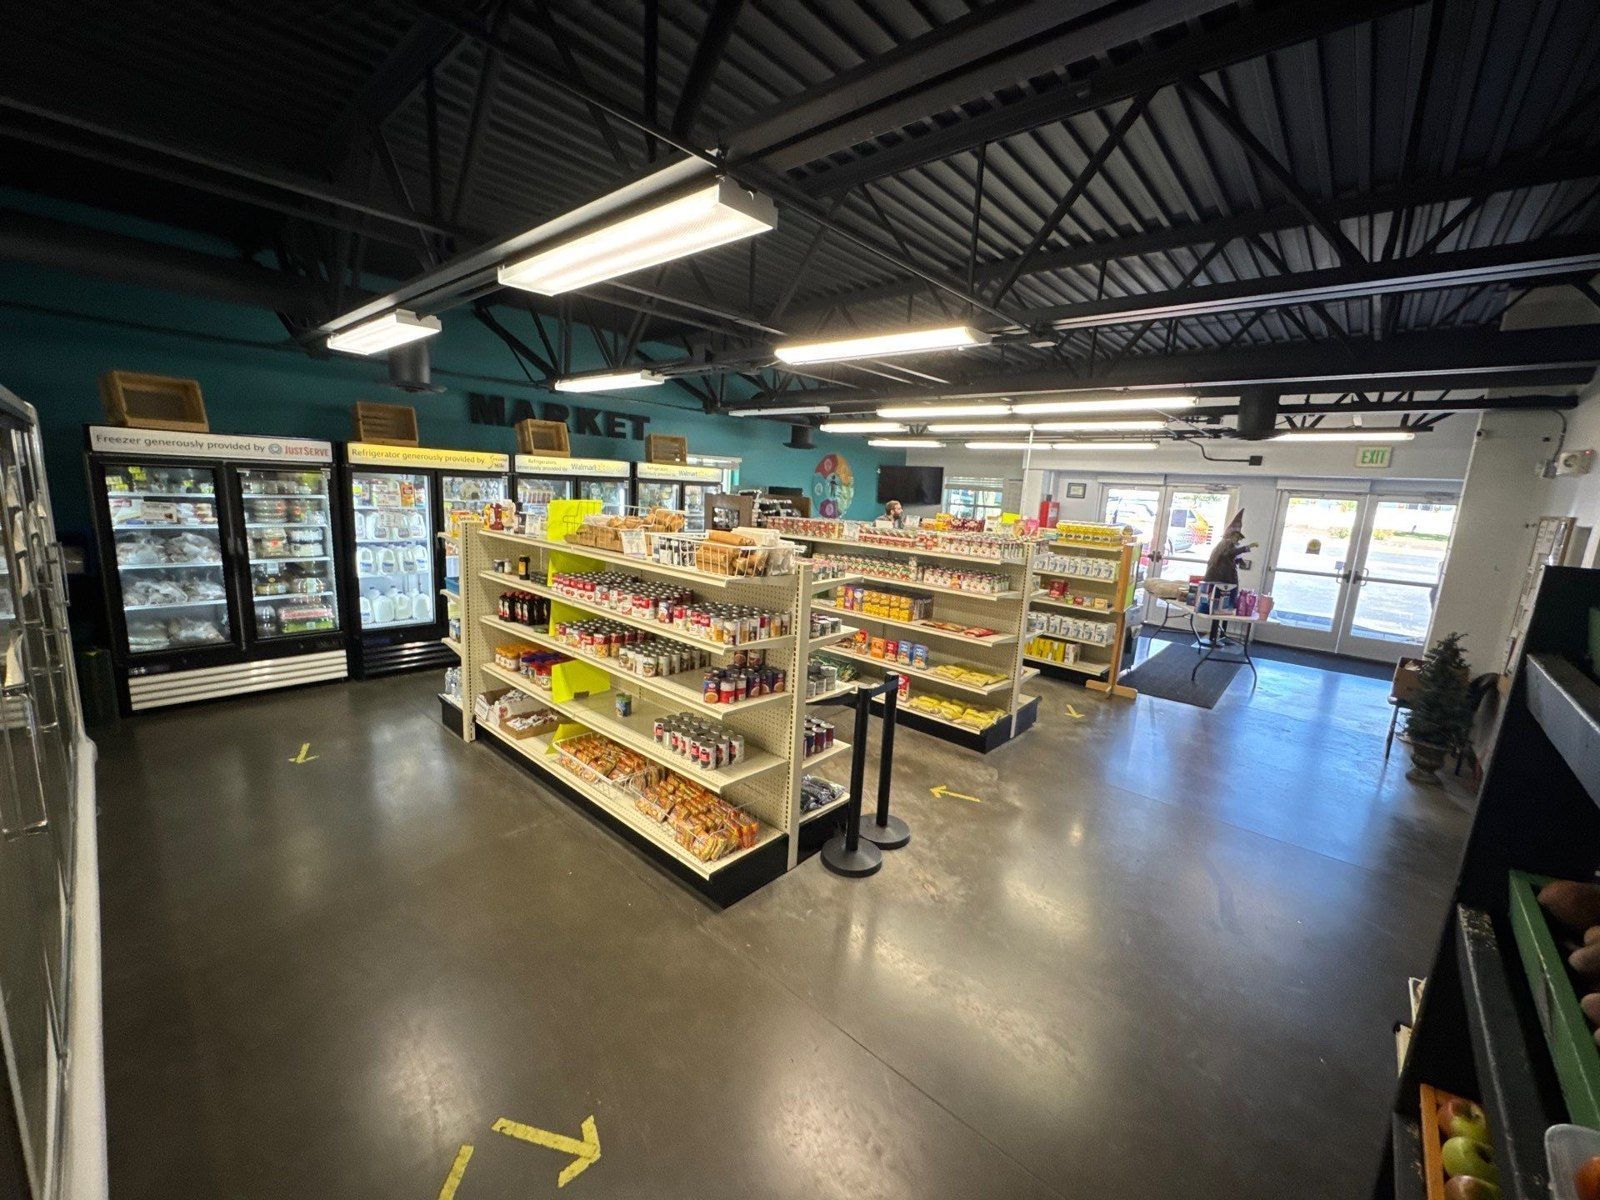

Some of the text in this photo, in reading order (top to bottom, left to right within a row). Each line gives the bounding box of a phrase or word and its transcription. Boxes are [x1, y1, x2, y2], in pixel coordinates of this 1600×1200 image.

[468, 391, 651, 441] MARKET
[96, 434, 140, 445] Freezer
[144, 438, 204, 448] generously
[207, 441, 251, 451] provided
[253, 443, 265, 453] by
[351, 448, 486, 465] Refrigerator generously provided by
[1361, 447, 1388, 464] EXIT
[571, 462, 597, 471] Walmart
